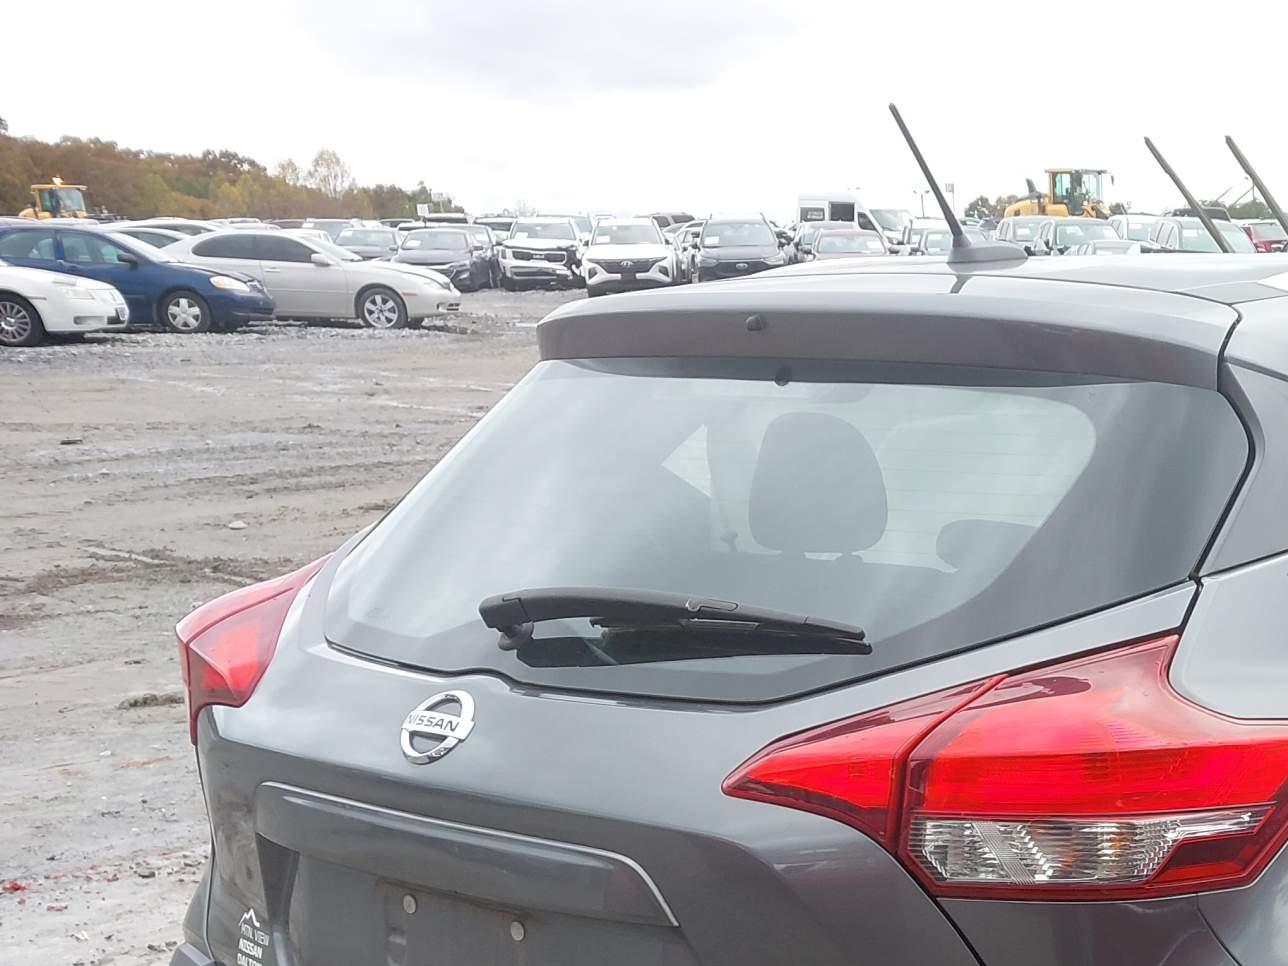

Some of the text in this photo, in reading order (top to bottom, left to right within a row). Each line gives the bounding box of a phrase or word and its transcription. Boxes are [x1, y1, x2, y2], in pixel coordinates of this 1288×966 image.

[408, 713, 460, 732] NISSAN
[254, 929, 270, 946] VIEW
[238, 938, 263, 959] NISSAN
